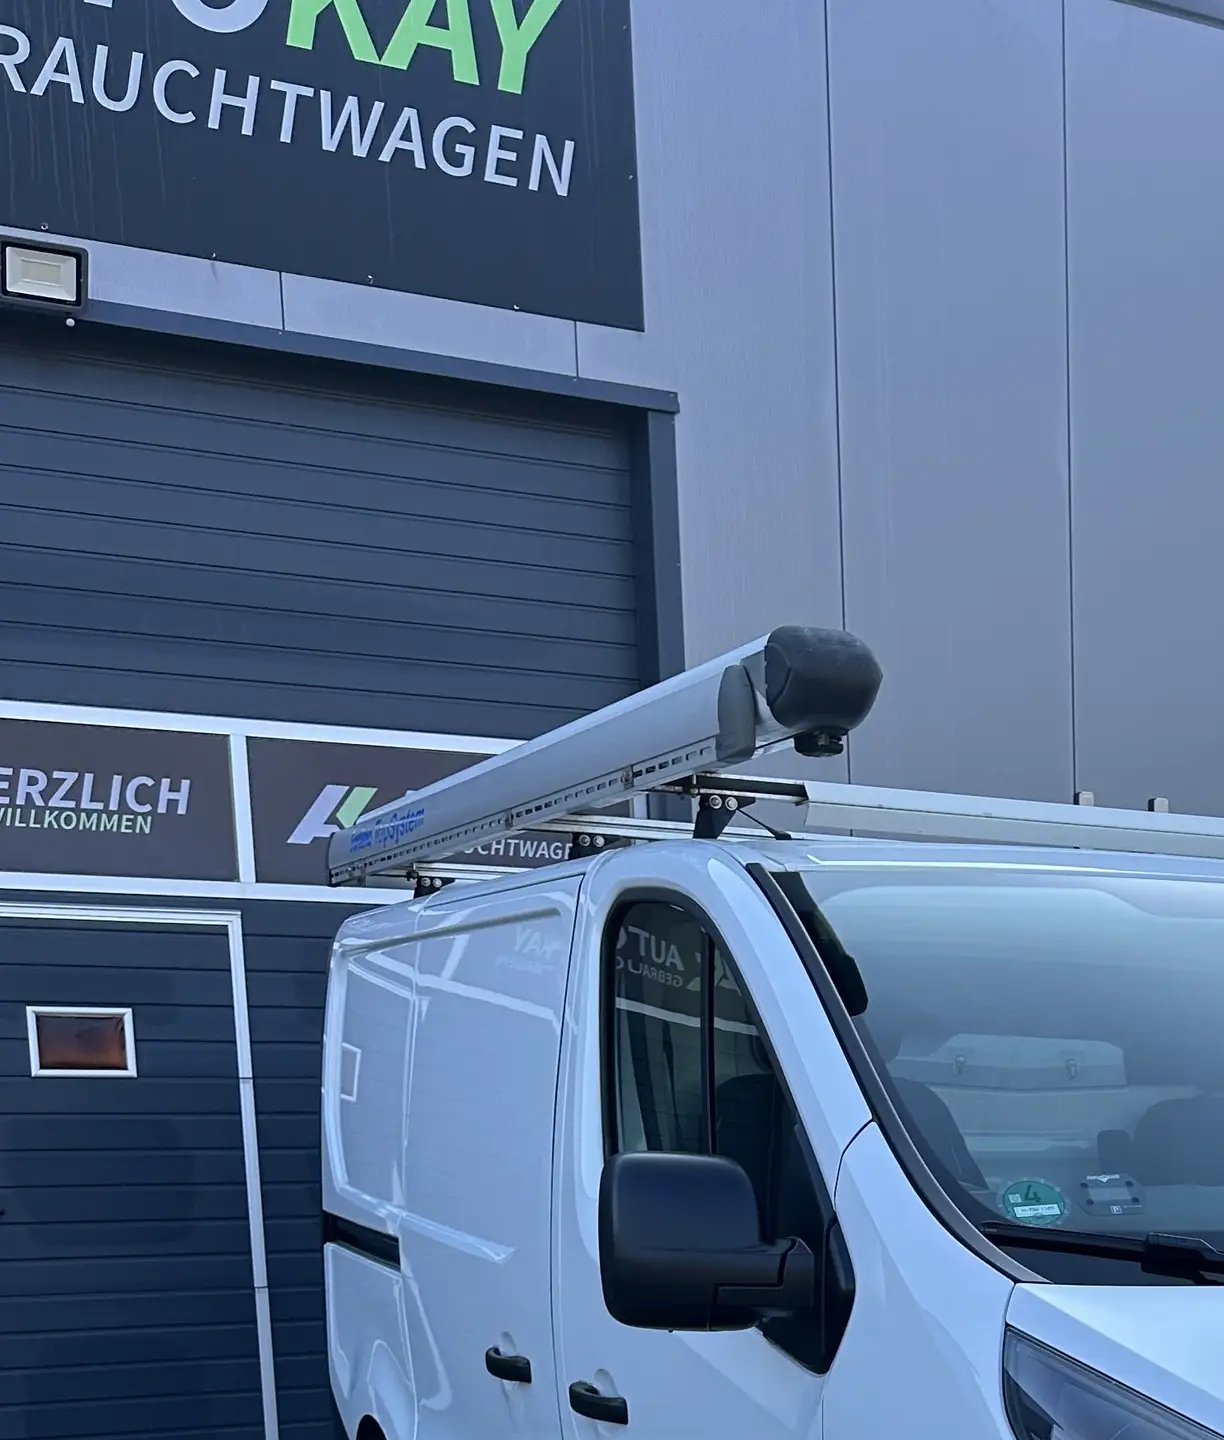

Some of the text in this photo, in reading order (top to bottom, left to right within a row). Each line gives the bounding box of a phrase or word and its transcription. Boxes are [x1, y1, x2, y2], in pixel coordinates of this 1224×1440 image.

[0, 25, 575, 197] RAUCHTWAGEN
[0, 807, 152, 834] ILLKOMMEN
[1024, 1183, 1042, 1204] 4
